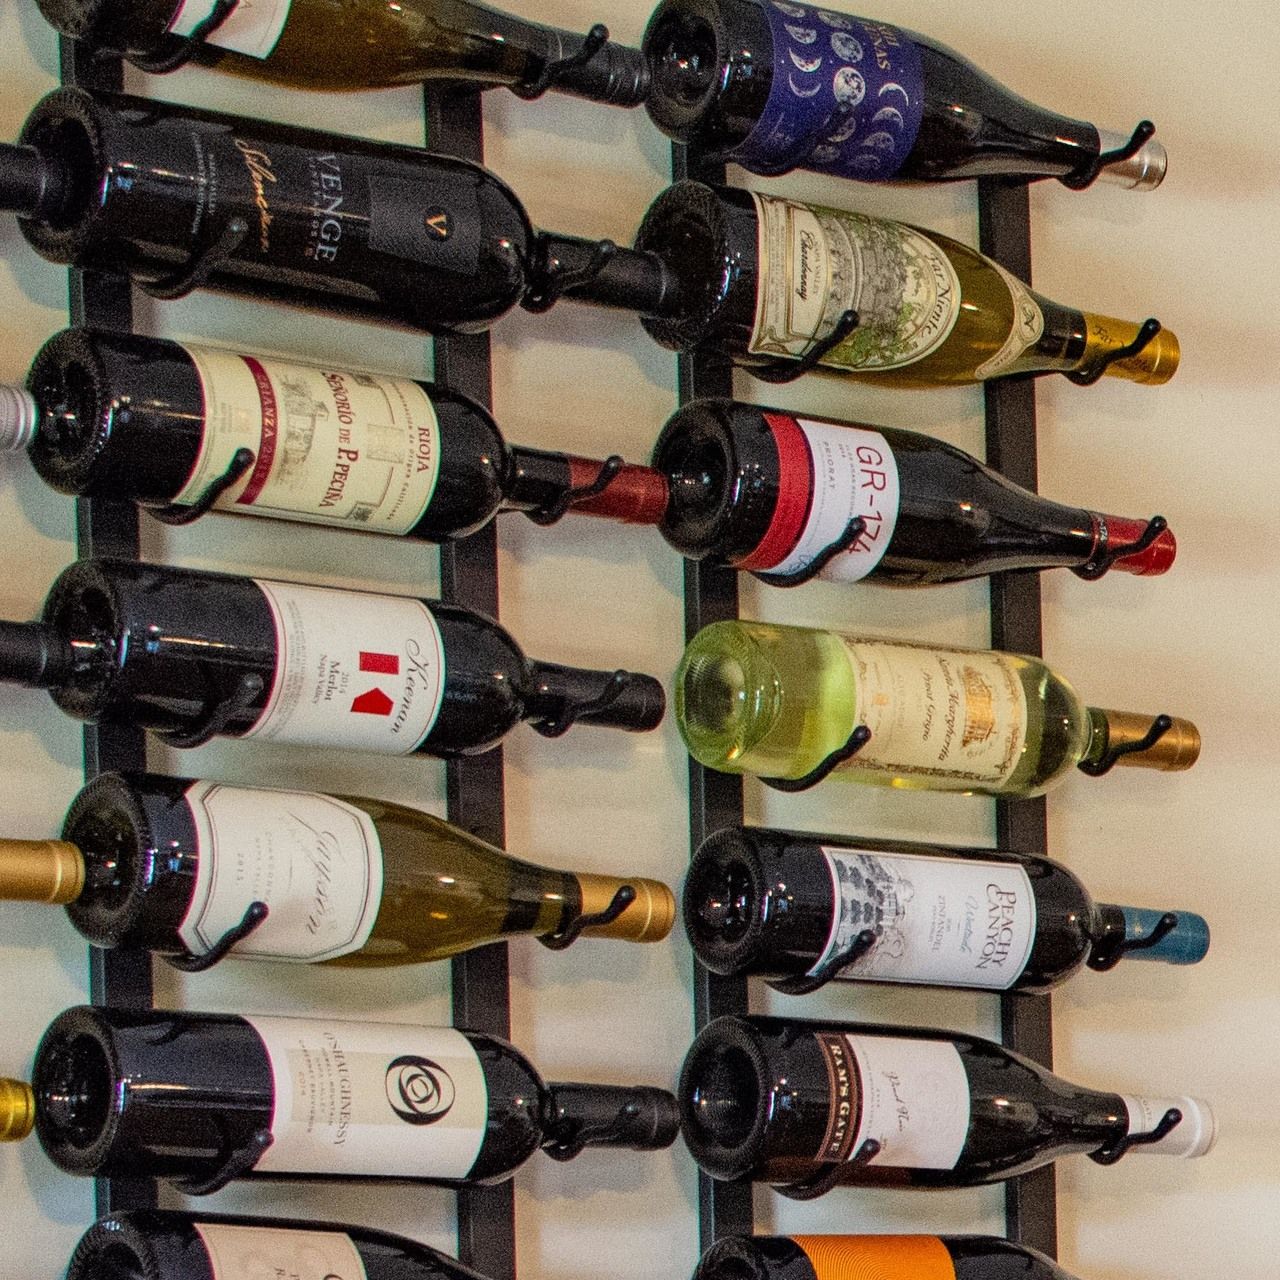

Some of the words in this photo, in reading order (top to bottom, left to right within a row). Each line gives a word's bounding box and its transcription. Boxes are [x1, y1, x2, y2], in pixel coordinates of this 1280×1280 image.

[314, 153, 342, 262] VENGE
[797, 229, 814, 302] Chardonnay
[924, 254, 945, 281] Far
[922, 284, 952, 335] Niente
[417, 426, 431, 472] RIOJA
[822, 441, 837, 489] PRIORAT
[320, 468, 350, 508] PECIÑA
[312, 679, 327, 705] Valley
[319, 654, 330, 678] Napa
[326, 660, 342, 702] Merlot
[389, 638, 430, 735] Keenan
[921, 704, 937, 742] Grigio
[936, 687, 961, 762] Margherita
[262, 831, 275, 904] CHARDONNA
[931, 895, 947, 953] ZINFANDEL
[975, 883, 1002, 970] CANYON
[991, 891, 1018, 967] PEACHY
[829, 1044, 850, 1098] RAM'S
[829, 1101, 850, 1154] GATE
